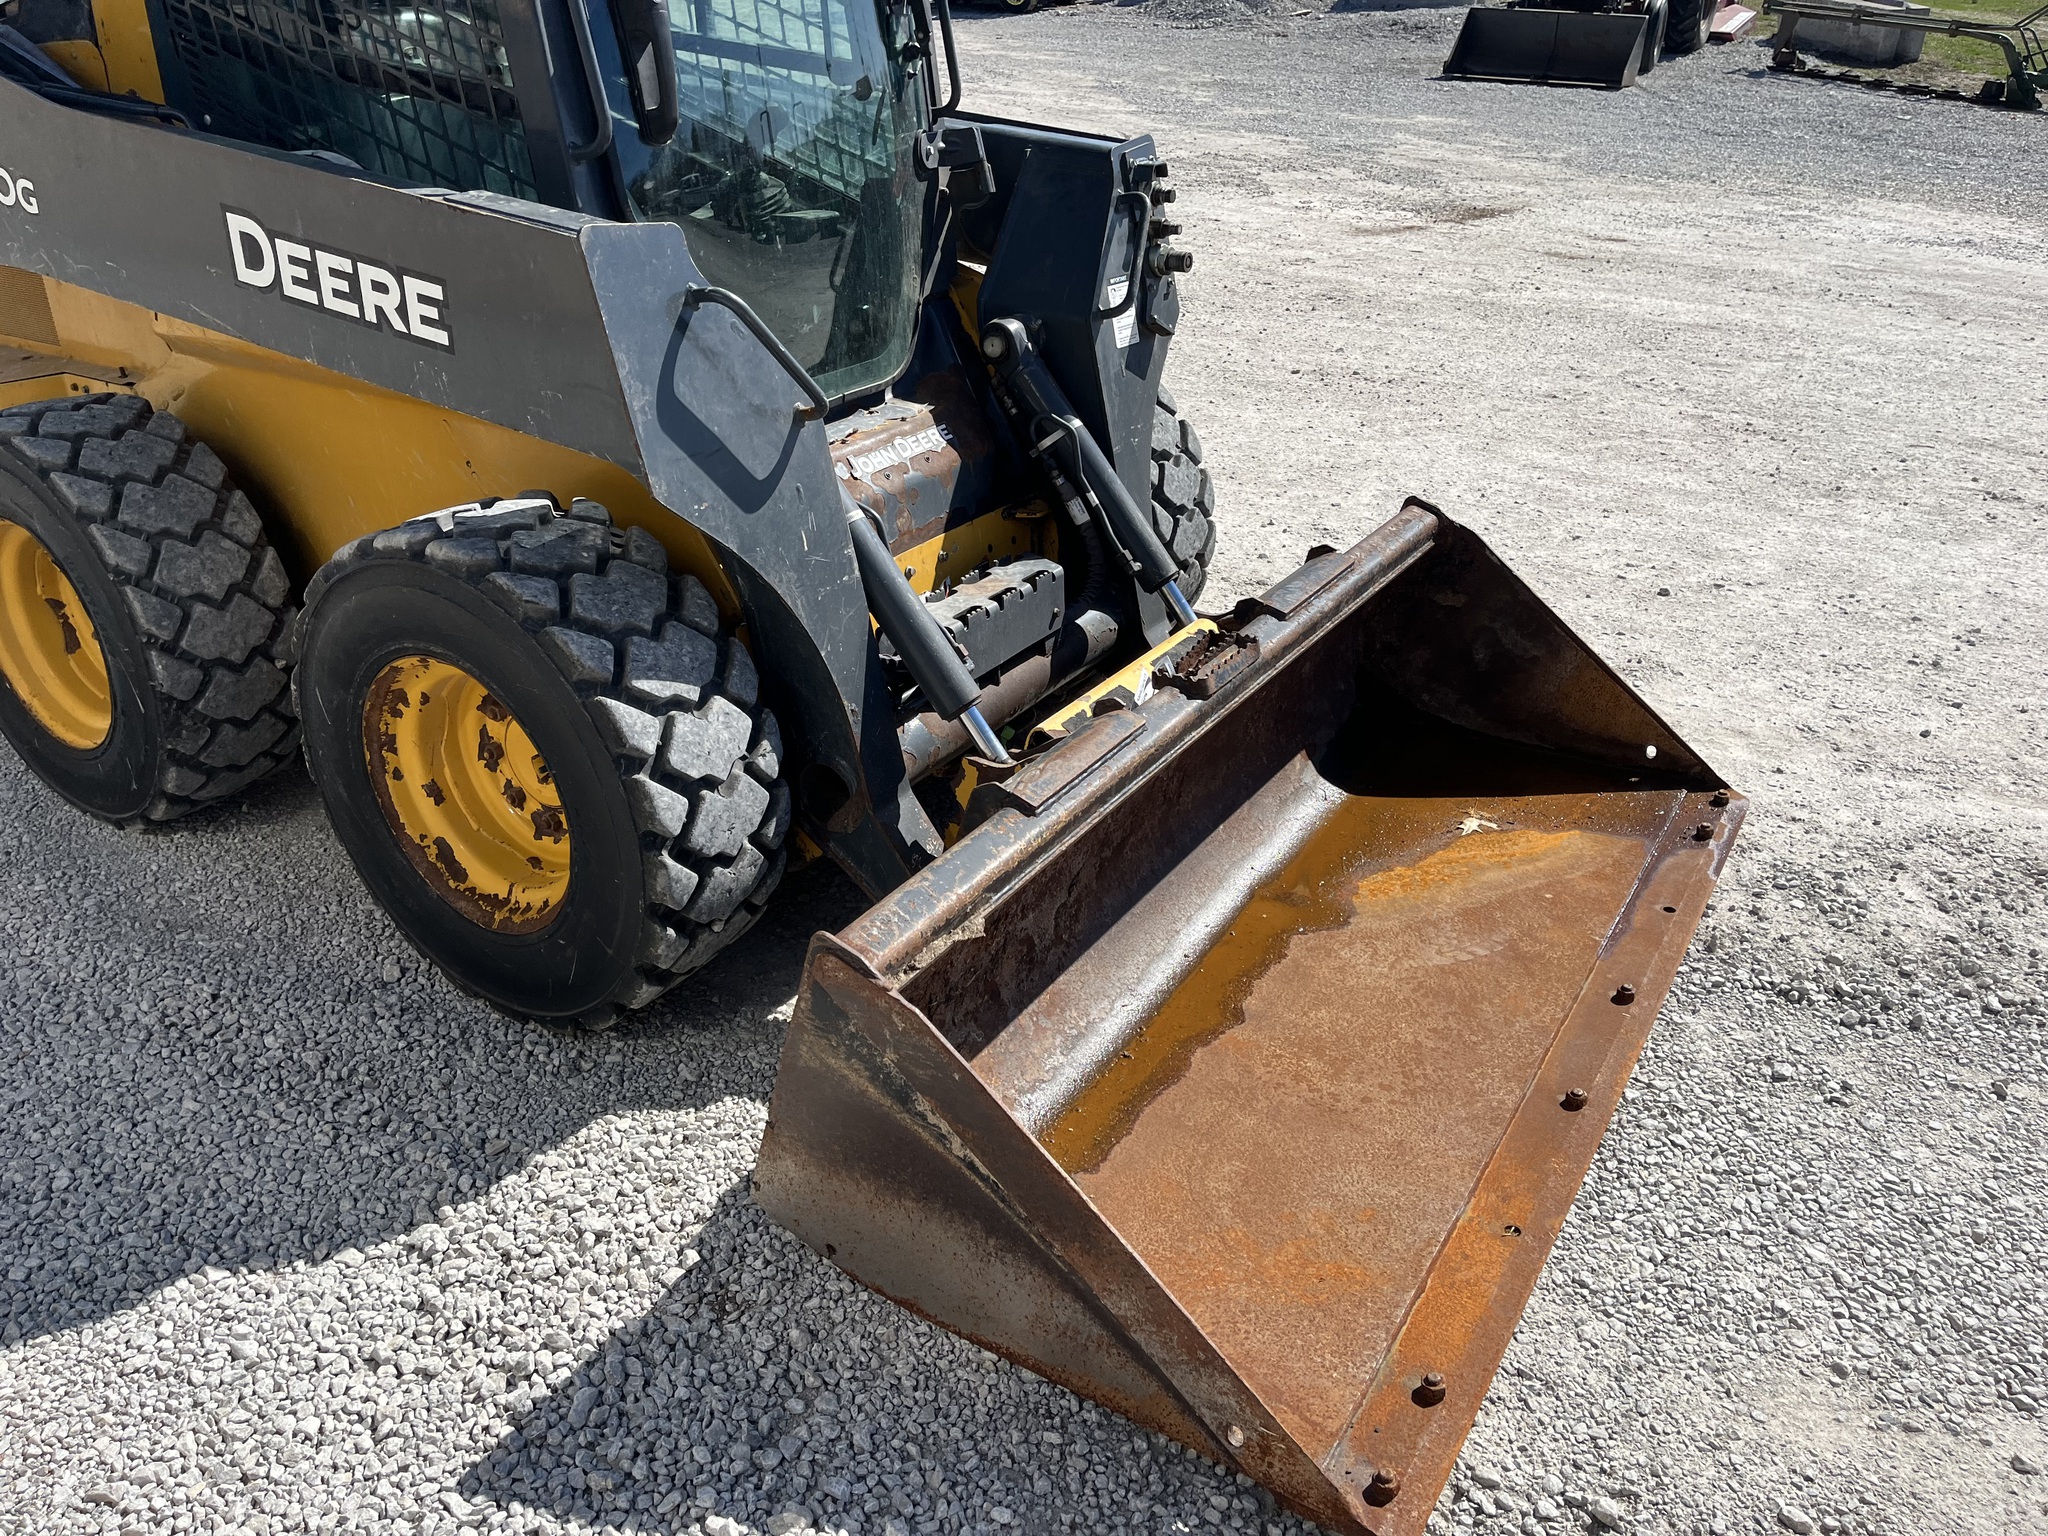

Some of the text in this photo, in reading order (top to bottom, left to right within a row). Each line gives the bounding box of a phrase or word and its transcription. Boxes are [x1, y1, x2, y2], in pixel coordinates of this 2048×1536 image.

[226, 212, 449, 346] DEERE
[848, 424, 953, 476] JOHN DEERE
